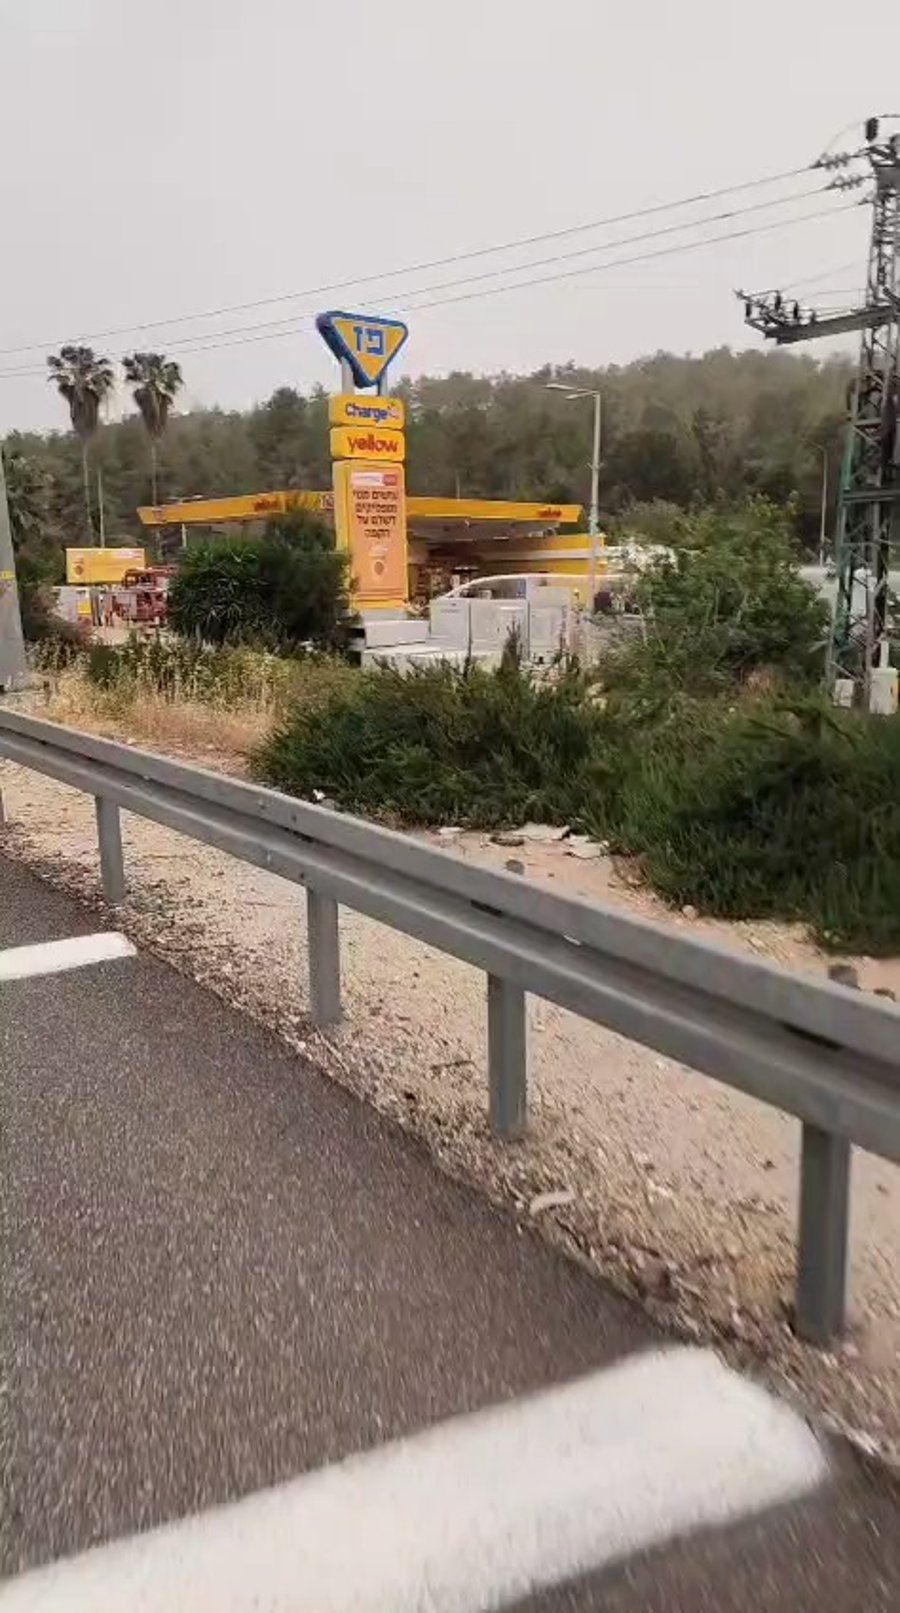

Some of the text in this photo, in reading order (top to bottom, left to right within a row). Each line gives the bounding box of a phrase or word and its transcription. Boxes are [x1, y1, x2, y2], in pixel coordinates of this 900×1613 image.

[353, 326, 385, 356] פז
[345, 402, 389, 423] Charge
[347, 434, 398, 453] yellow
